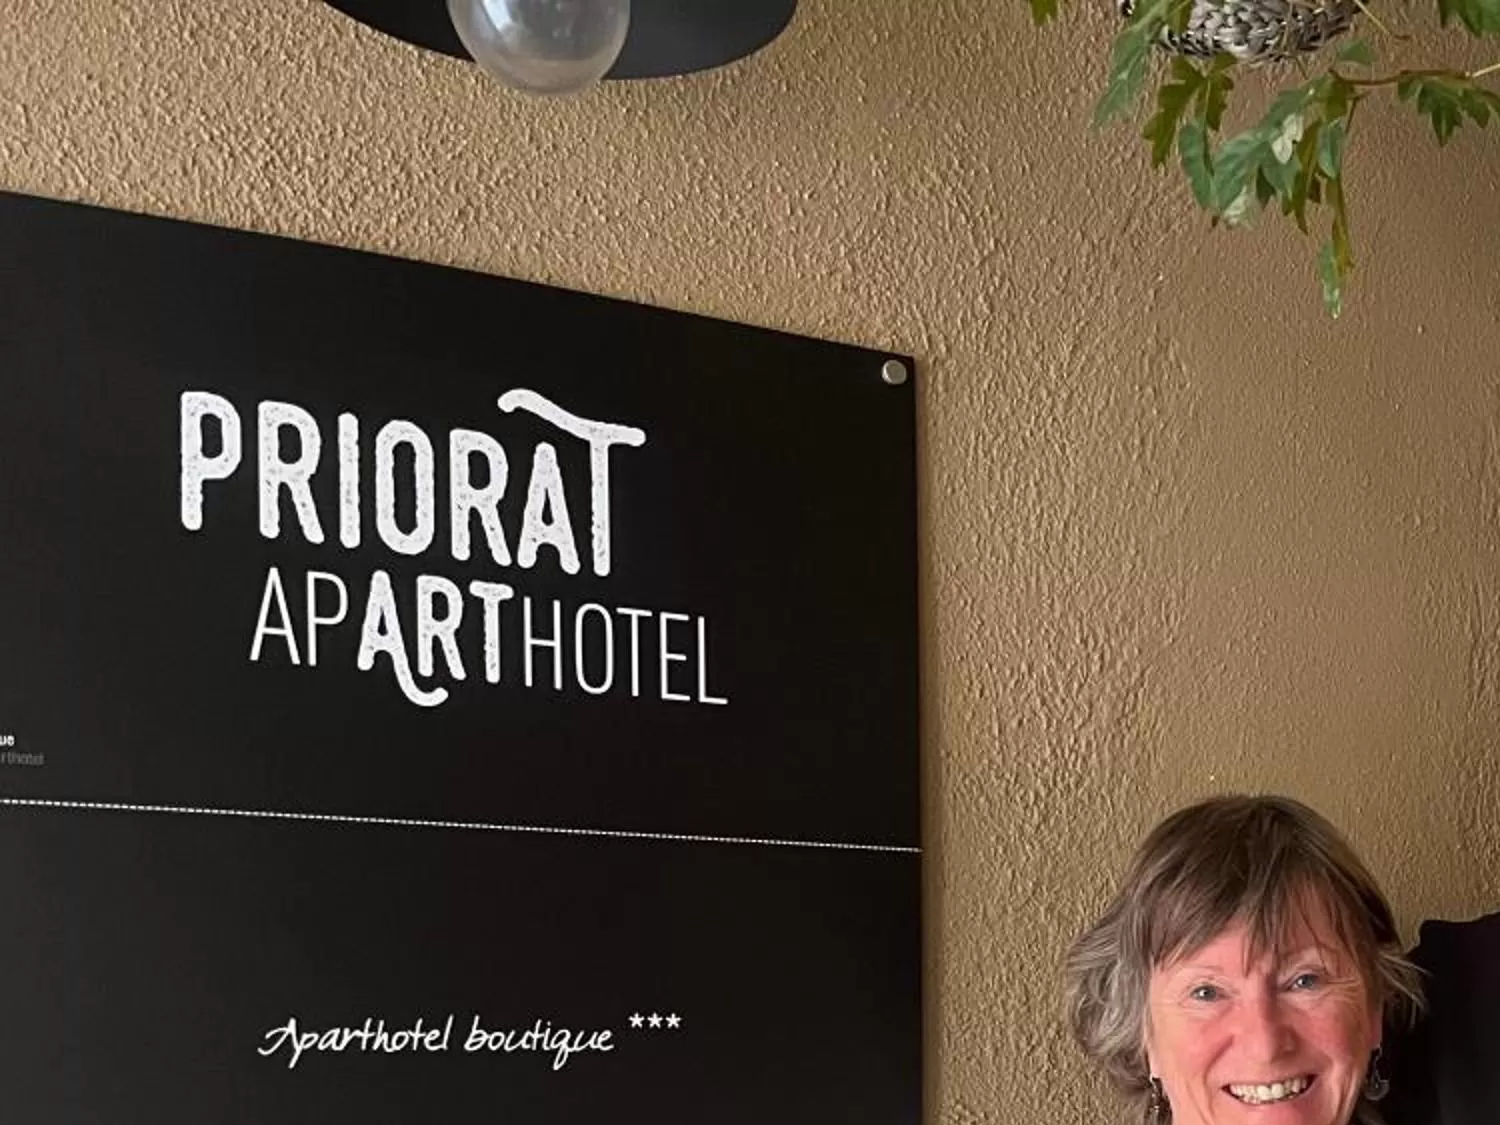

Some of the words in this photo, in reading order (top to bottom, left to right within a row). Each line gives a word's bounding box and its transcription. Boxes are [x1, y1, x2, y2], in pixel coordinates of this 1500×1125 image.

[180, 389, 646, 576] PRIORAT
[250, 566, 728, 706] APARTHOTEL
[258, 1013, 454, 1068] Aparthotel
[464, 1014, 614, 1070] boutique
